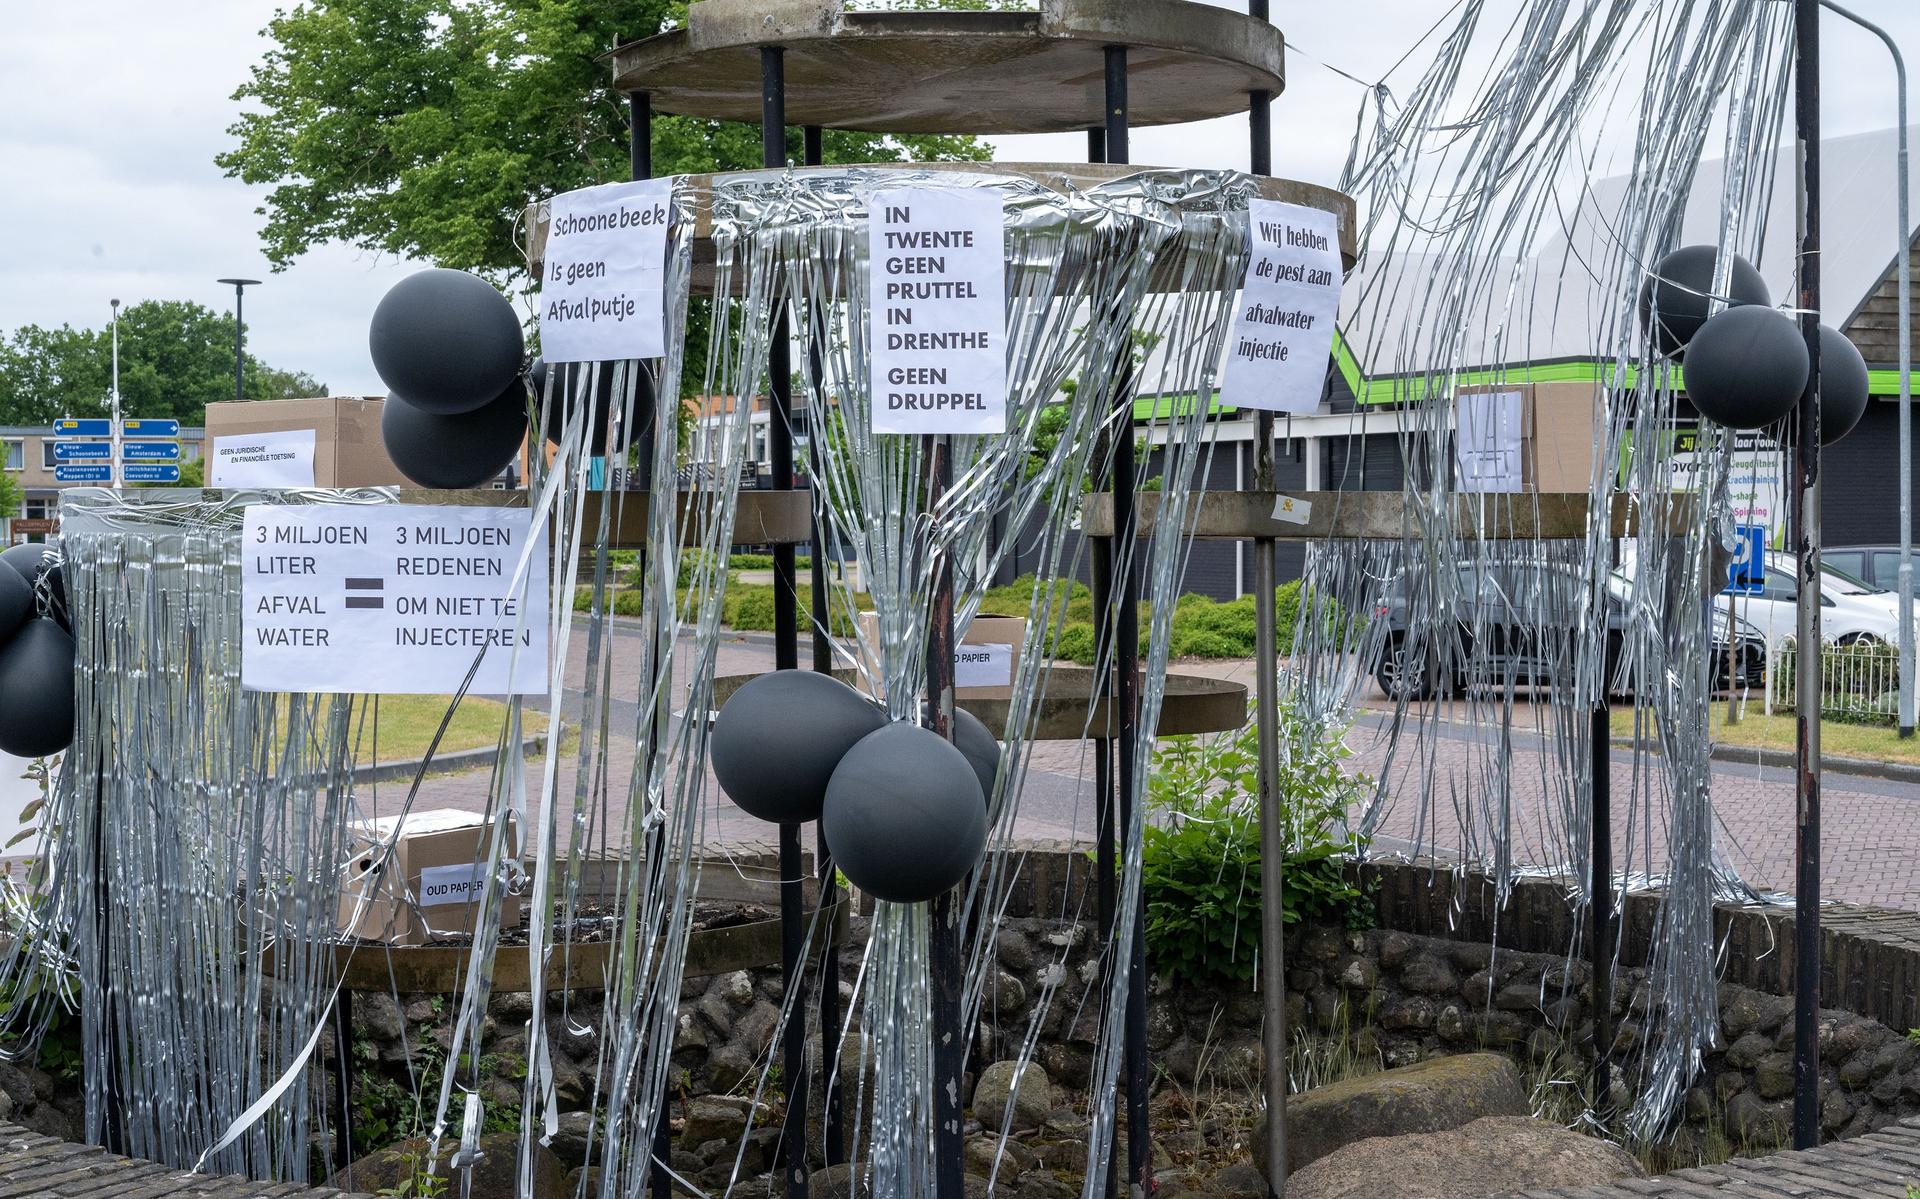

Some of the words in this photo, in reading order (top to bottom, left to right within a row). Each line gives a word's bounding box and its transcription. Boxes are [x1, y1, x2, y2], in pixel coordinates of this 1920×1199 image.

[554, 203, 666, 237] Schoonebeek
[885, 206, 910, 224] IN
[885, 230, 973, 249] TWENTE
[1259, 221, 1282, 248] Wij
[1286, 225, 1329, 251] hebben
[551, 261, 563, 281] Is
[567, 261, 606, 285] geen
[886, 256, 945, 275] GEEN
[1255, 257, 1273, 278] de
[1275, 263, 1305, 283] pest
[1308, 268, 1332, 286] aan
[886, 281, 977, 300] PRUTTEL
[547, 293, 635, 322] Afvalputje
[887, 307, 912, 325] IN
[1245, 302, 1315, 330] afvalwater
[887, 331, 989, 350] DRENTHE
[1238, 336, 1289, 361] injectie
[888, 367, 947, 386] GEEN
[888, 393, 987, 410] DRUPPEL
[220, 448, 235, 456] GEEN
[235, 446, 267, 455] JURIDISCHE
[1680, 437, 1694, 451] Jij
[1735, 437, 1753, 448] laar
[239, 454, 270, 463] FINANCIËLE
[271, 453, 296, 461] TOETSING
[256, 525, 267, 544] 3
[275, 526, 368, 544] MILJOEN
[396, 526, 407, 545] 3
[415, 527, 511, 546] MILJOEN
[256, 556, 316, 574] LITER
[397, 557, 502, 576] REDENEN
[256, 596, 326, 614] AFVAL
[396, 597, 427, 615] OM
[436, 598, 485, 616] NIET
[490, 598, 517, 616] TE
[256, 628, 329, 646] WATER
[396, 627, 530, 647] INJECTEREN
[961, 653, 991, 663] PAPIER
[427, 884, 448, 896] OUD
[450, 881, 484, 894] PAPIER
